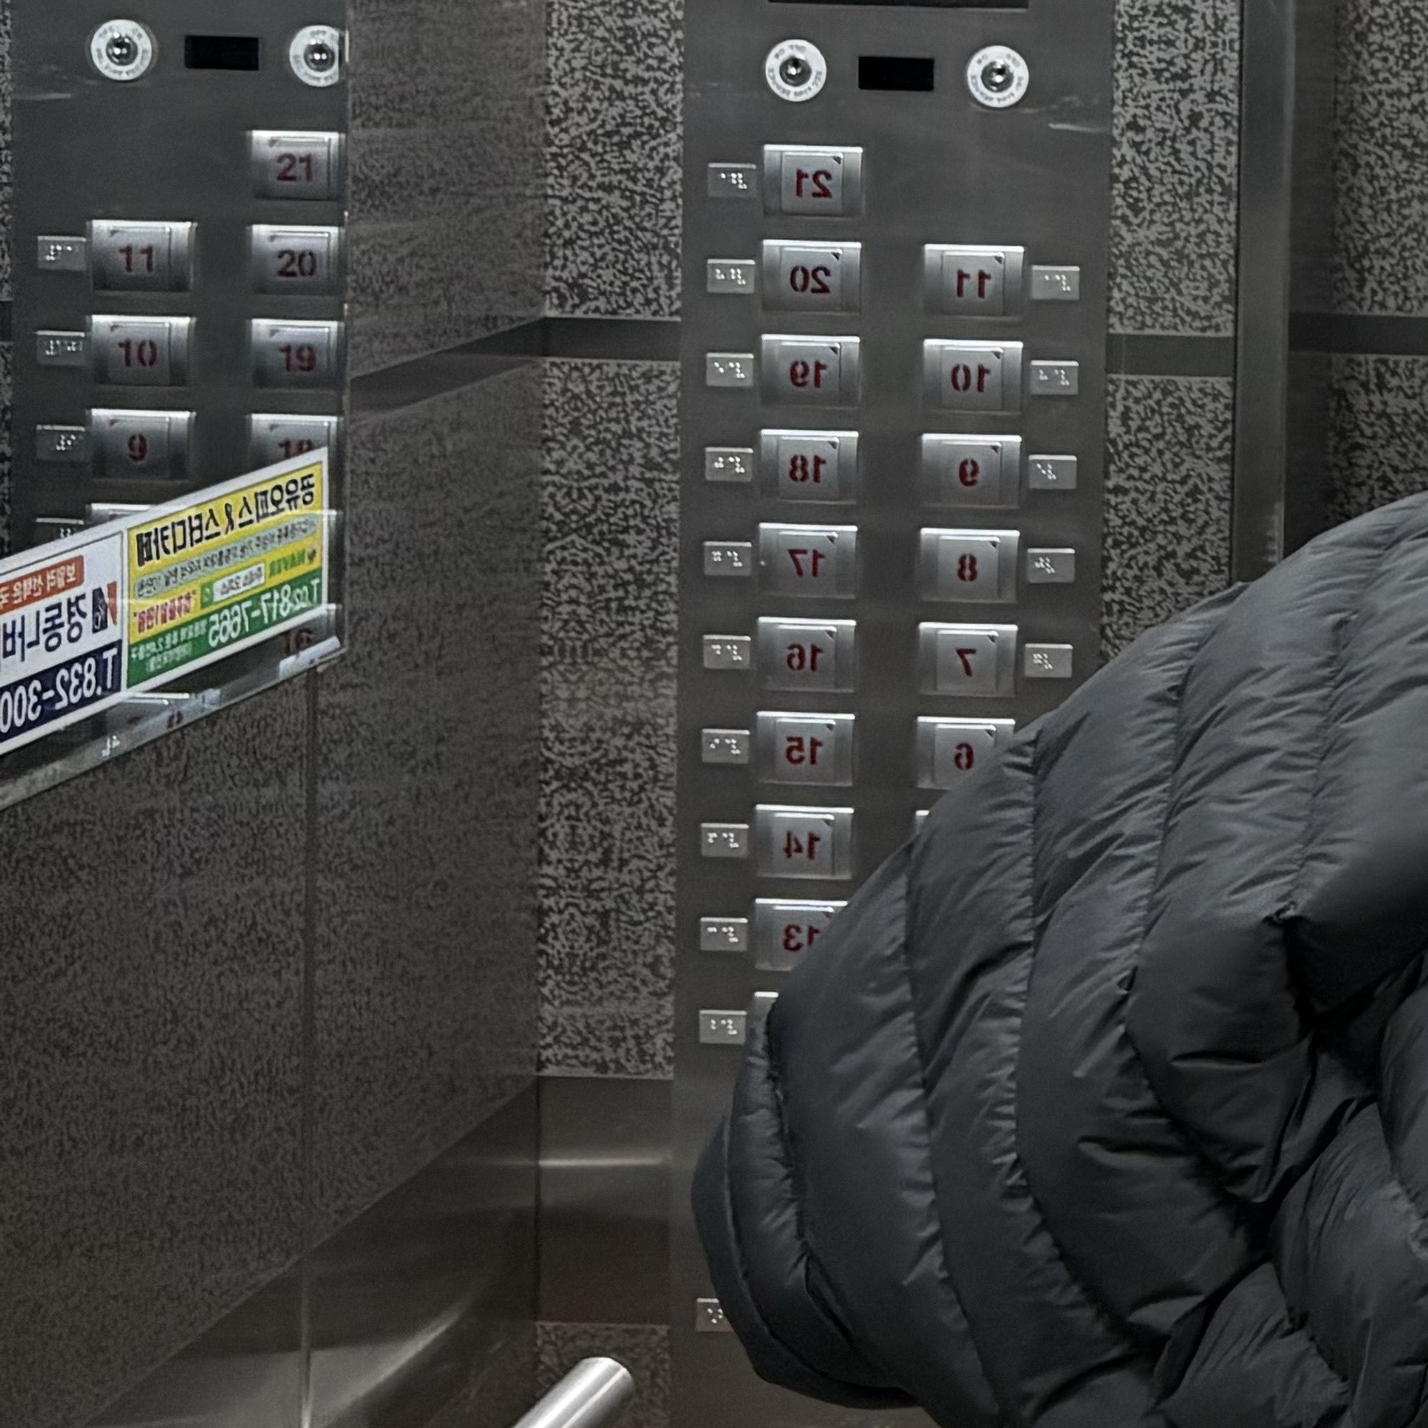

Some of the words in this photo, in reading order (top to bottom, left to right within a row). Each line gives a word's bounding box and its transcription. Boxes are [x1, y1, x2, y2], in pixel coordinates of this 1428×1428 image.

[277, 153, 313, 182] 21
[119, 246, 154, 273] 11
[277, 251, 316, 278] 20
[119, 340, 157, 368] 10
[280, 344, 316, 372] 19
[128, 435, 147, 461] 9
